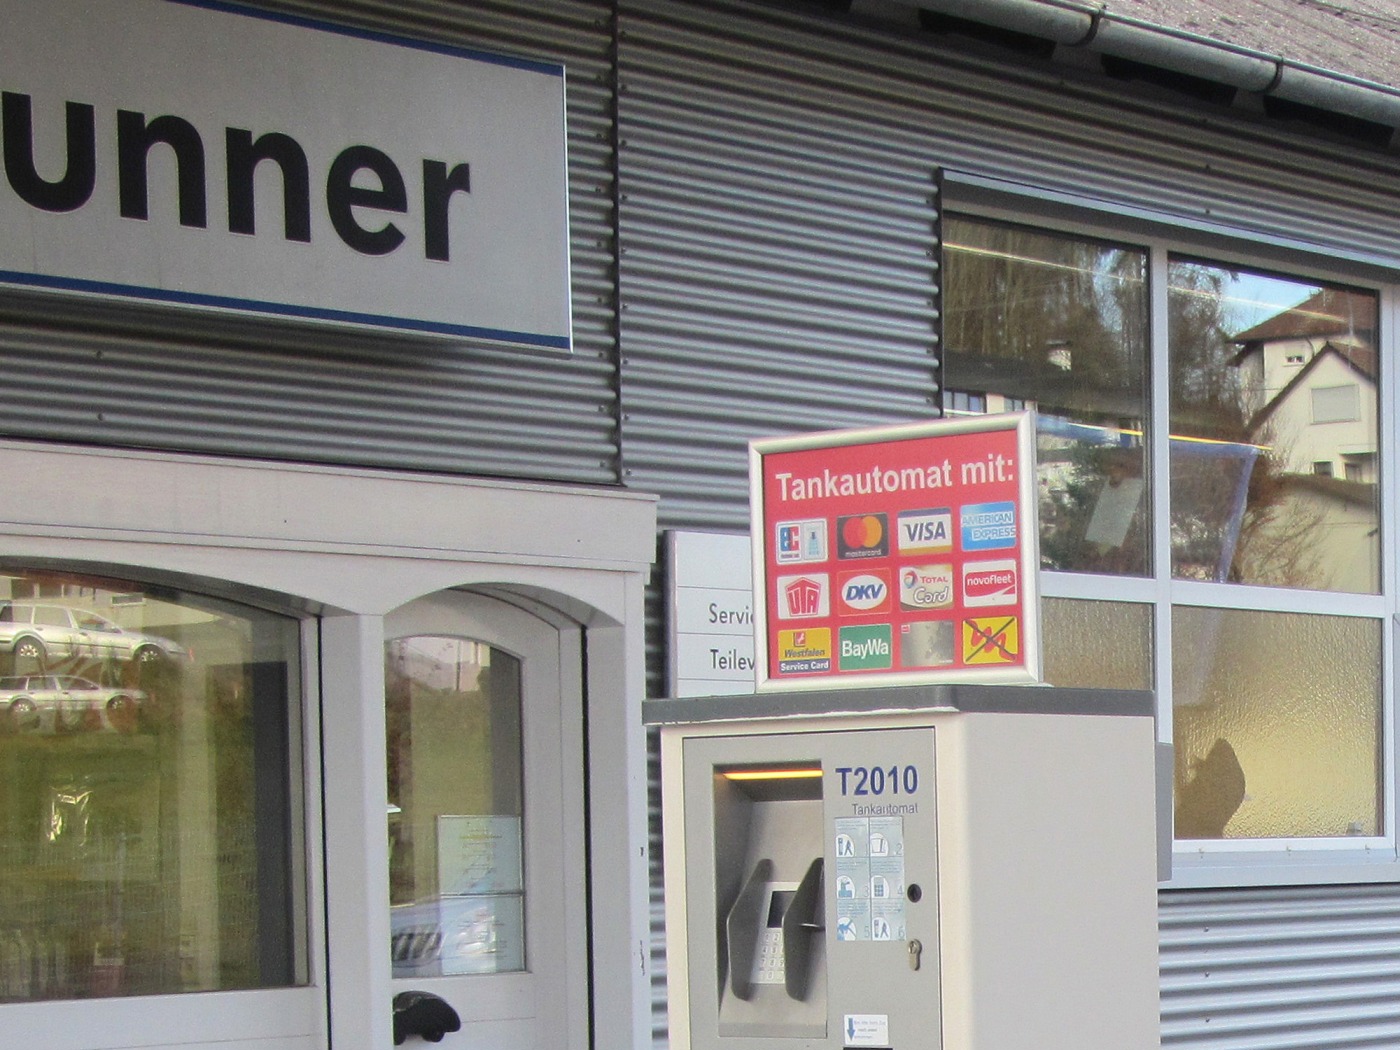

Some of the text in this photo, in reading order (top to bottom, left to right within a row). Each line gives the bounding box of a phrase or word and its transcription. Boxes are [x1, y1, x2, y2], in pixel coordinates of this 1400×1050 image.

[2, 91, 471, 262] unner
[775, 454, 1014, 501] Tankautomat mit:
[904, 522, 946, 541] VISA
[973, 527, 1016, 539] EXPRESS
[921, 576, 948, 584] TOTAL
[967, 574, 1011, 586] novofleet
[846, 584, 883, 601] DKV
[913, 586, 949, 604] Card
[842, 639, 889, 659] BayWa
[781, 661, 829, 671] Service Card
[835, 765, 918, 796] T2010
[852, 803, 918, 815] Tankautomat
